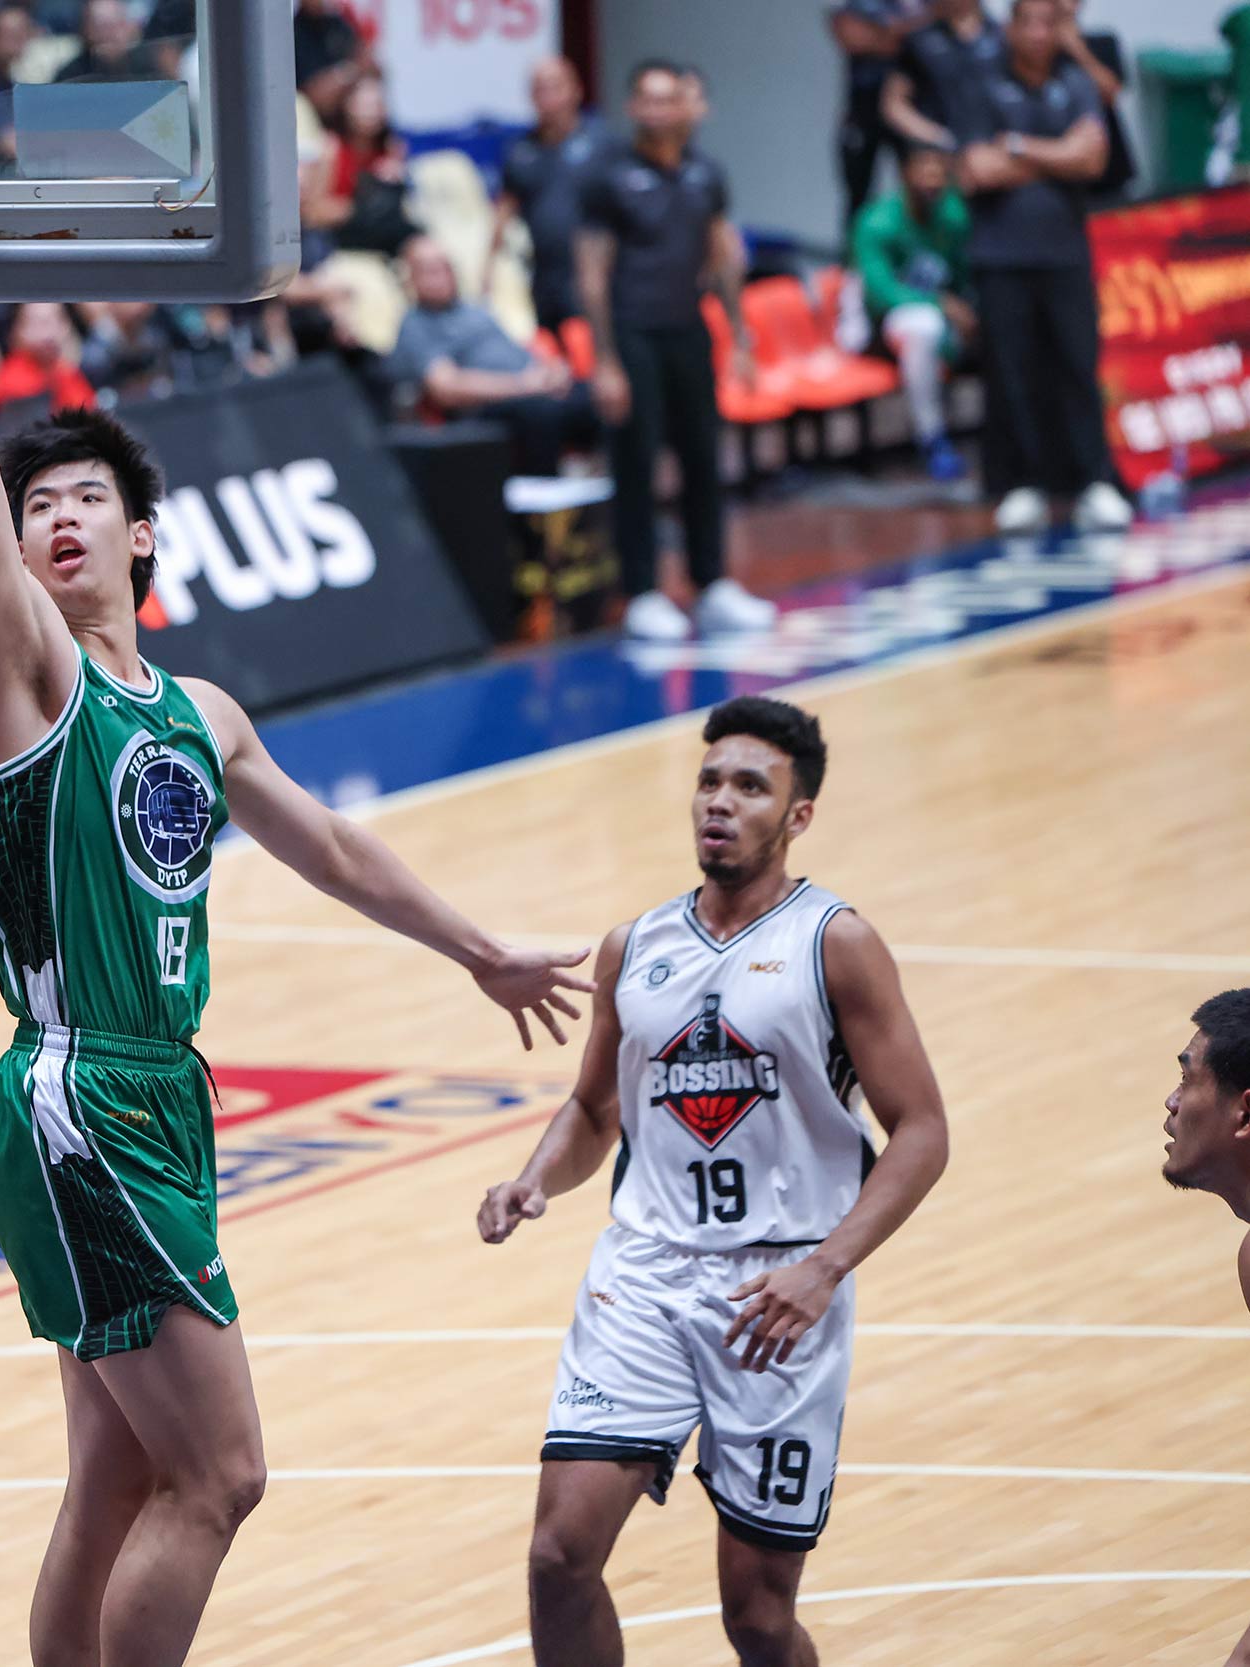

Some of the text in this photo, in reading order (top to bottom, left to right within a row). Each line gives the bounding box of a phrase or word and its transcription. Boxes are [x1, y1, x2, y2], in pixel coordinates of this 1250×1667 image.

[157, 867, 189, 887] DYIP
[650, 1054, 778, 1098] BOSSING
[687, 1158, 747, 1225] 19
[557, 1390, 615, 1412] Organics
[756, 1437, 812, 1506] 19
